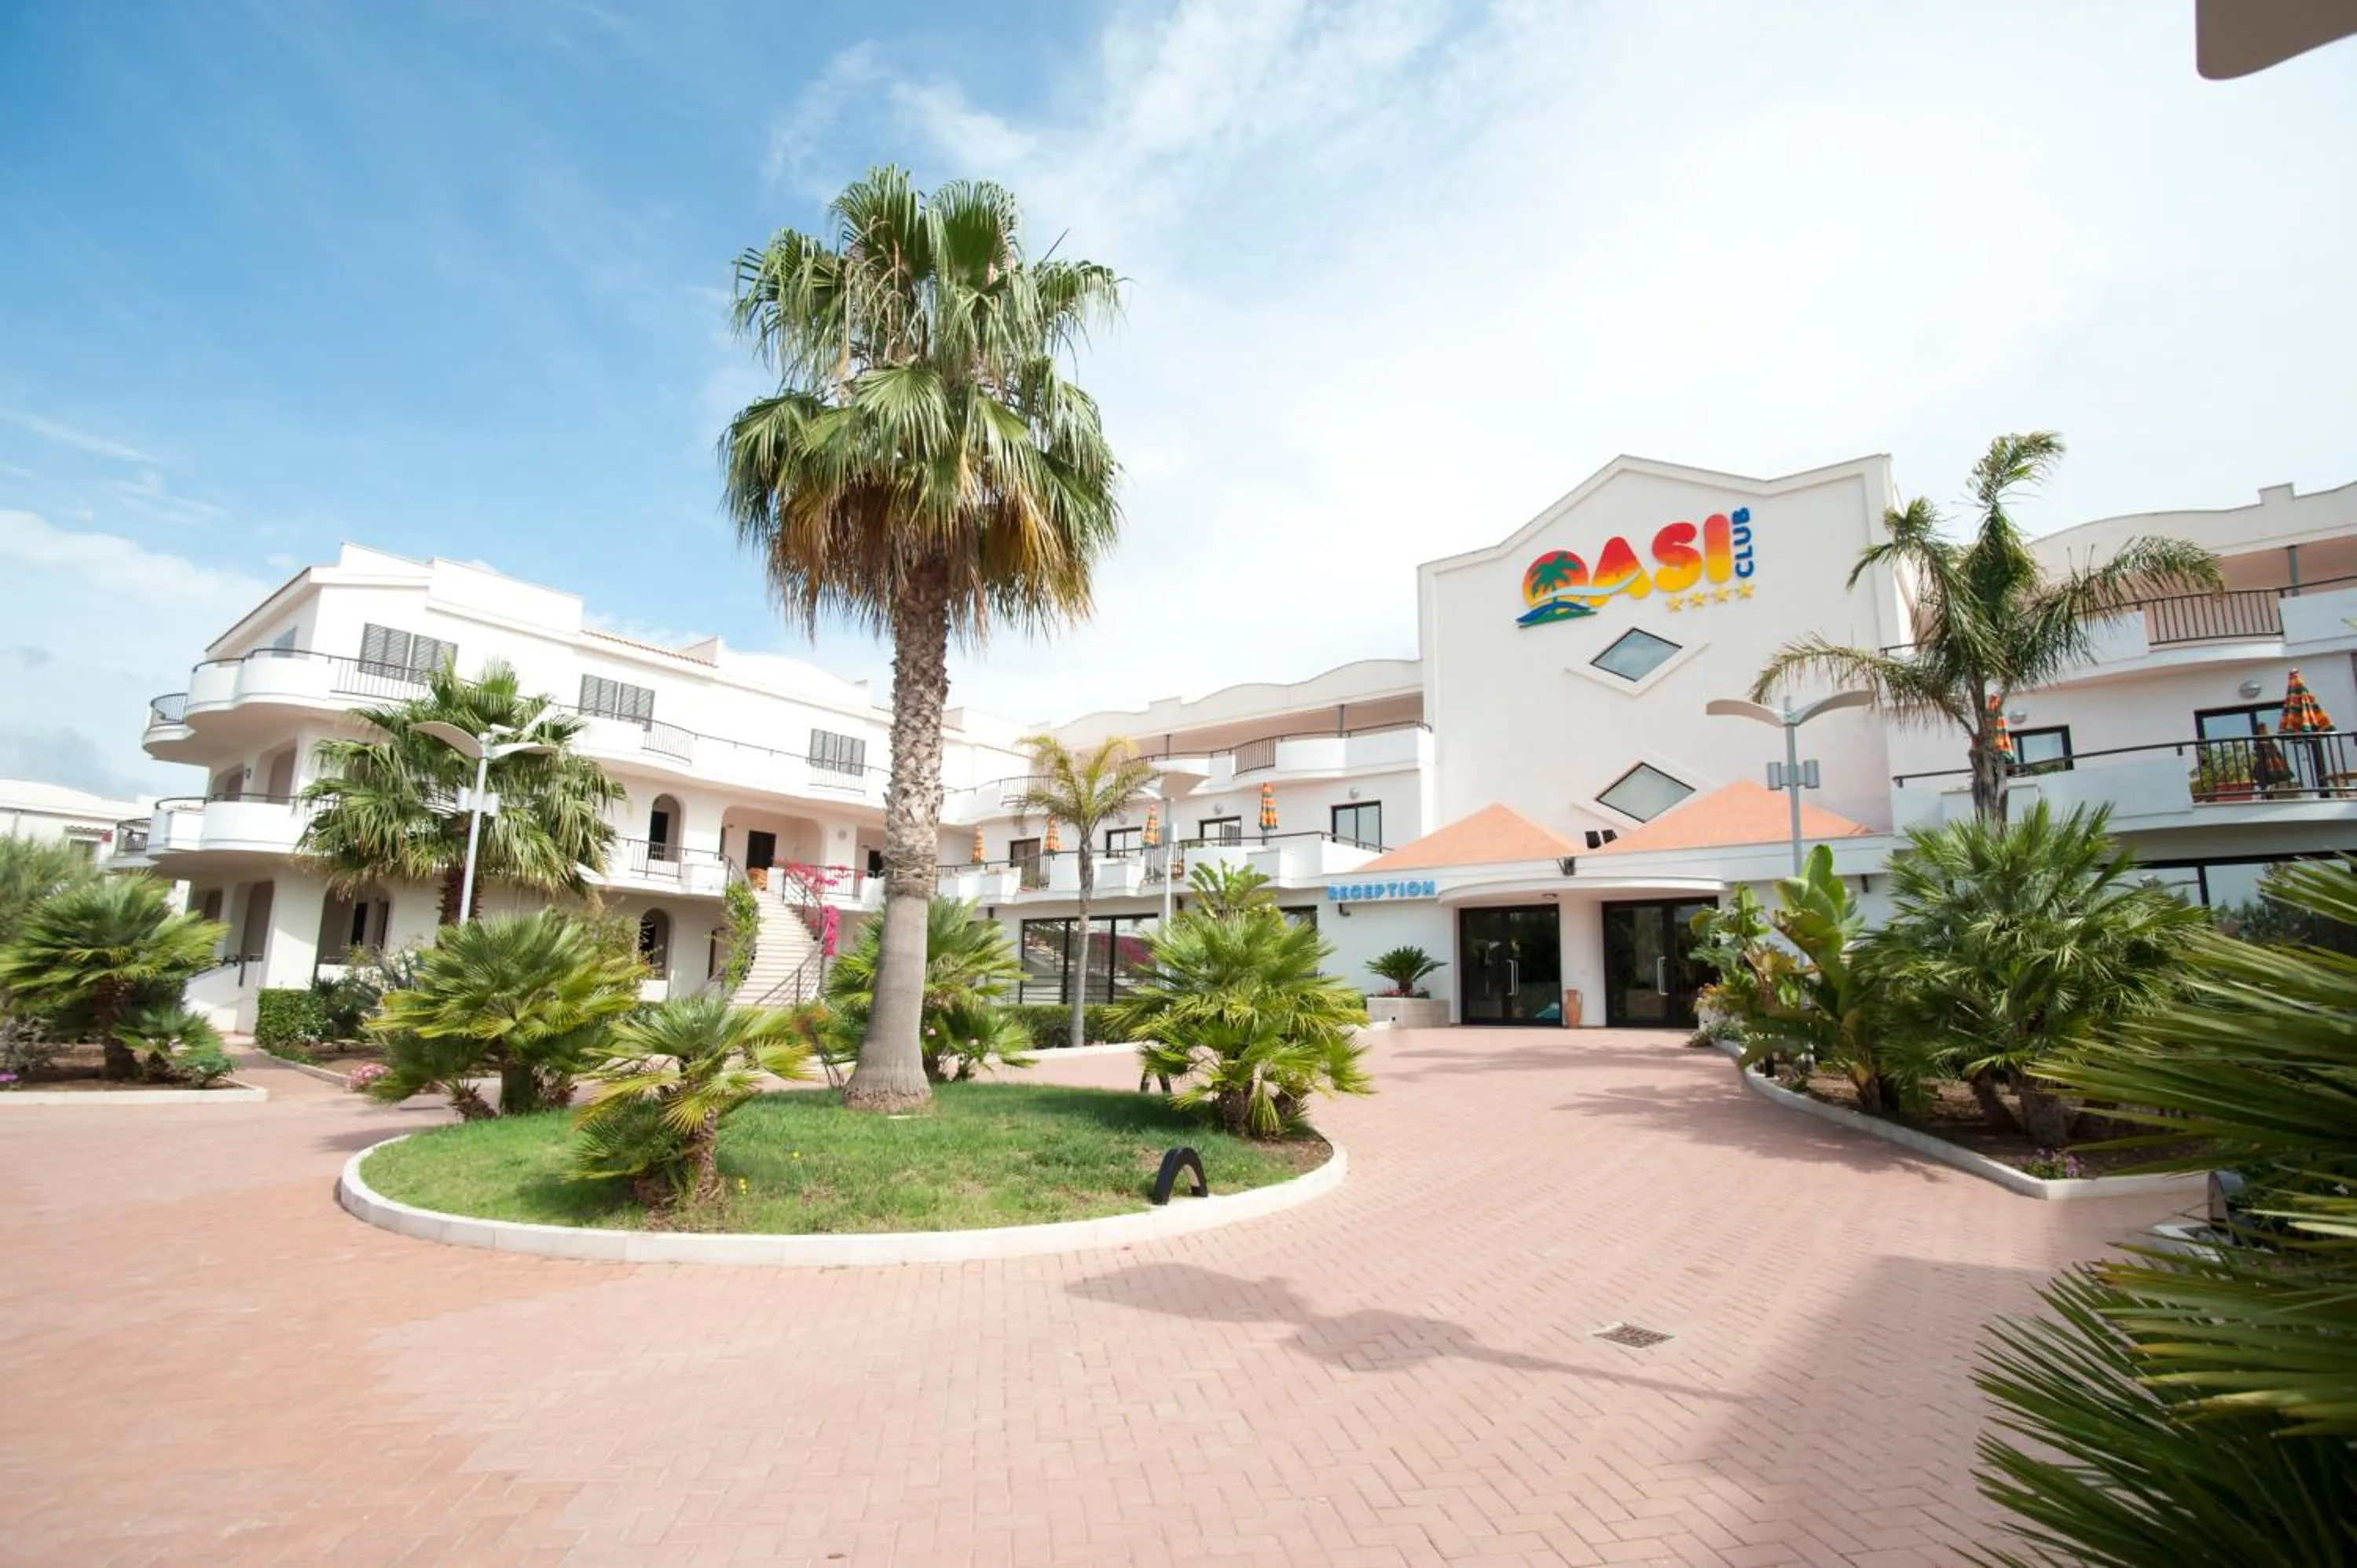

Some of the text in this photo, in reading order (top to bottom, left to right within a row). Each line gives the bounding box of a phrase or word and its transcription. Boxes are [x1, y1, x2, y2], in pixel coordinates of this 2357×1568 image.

[1522, 514, 1732, 607] OASI
[1732, 507, 1755, 578] CLUB
[1328, 880, 1435, 900] RECEPTION
